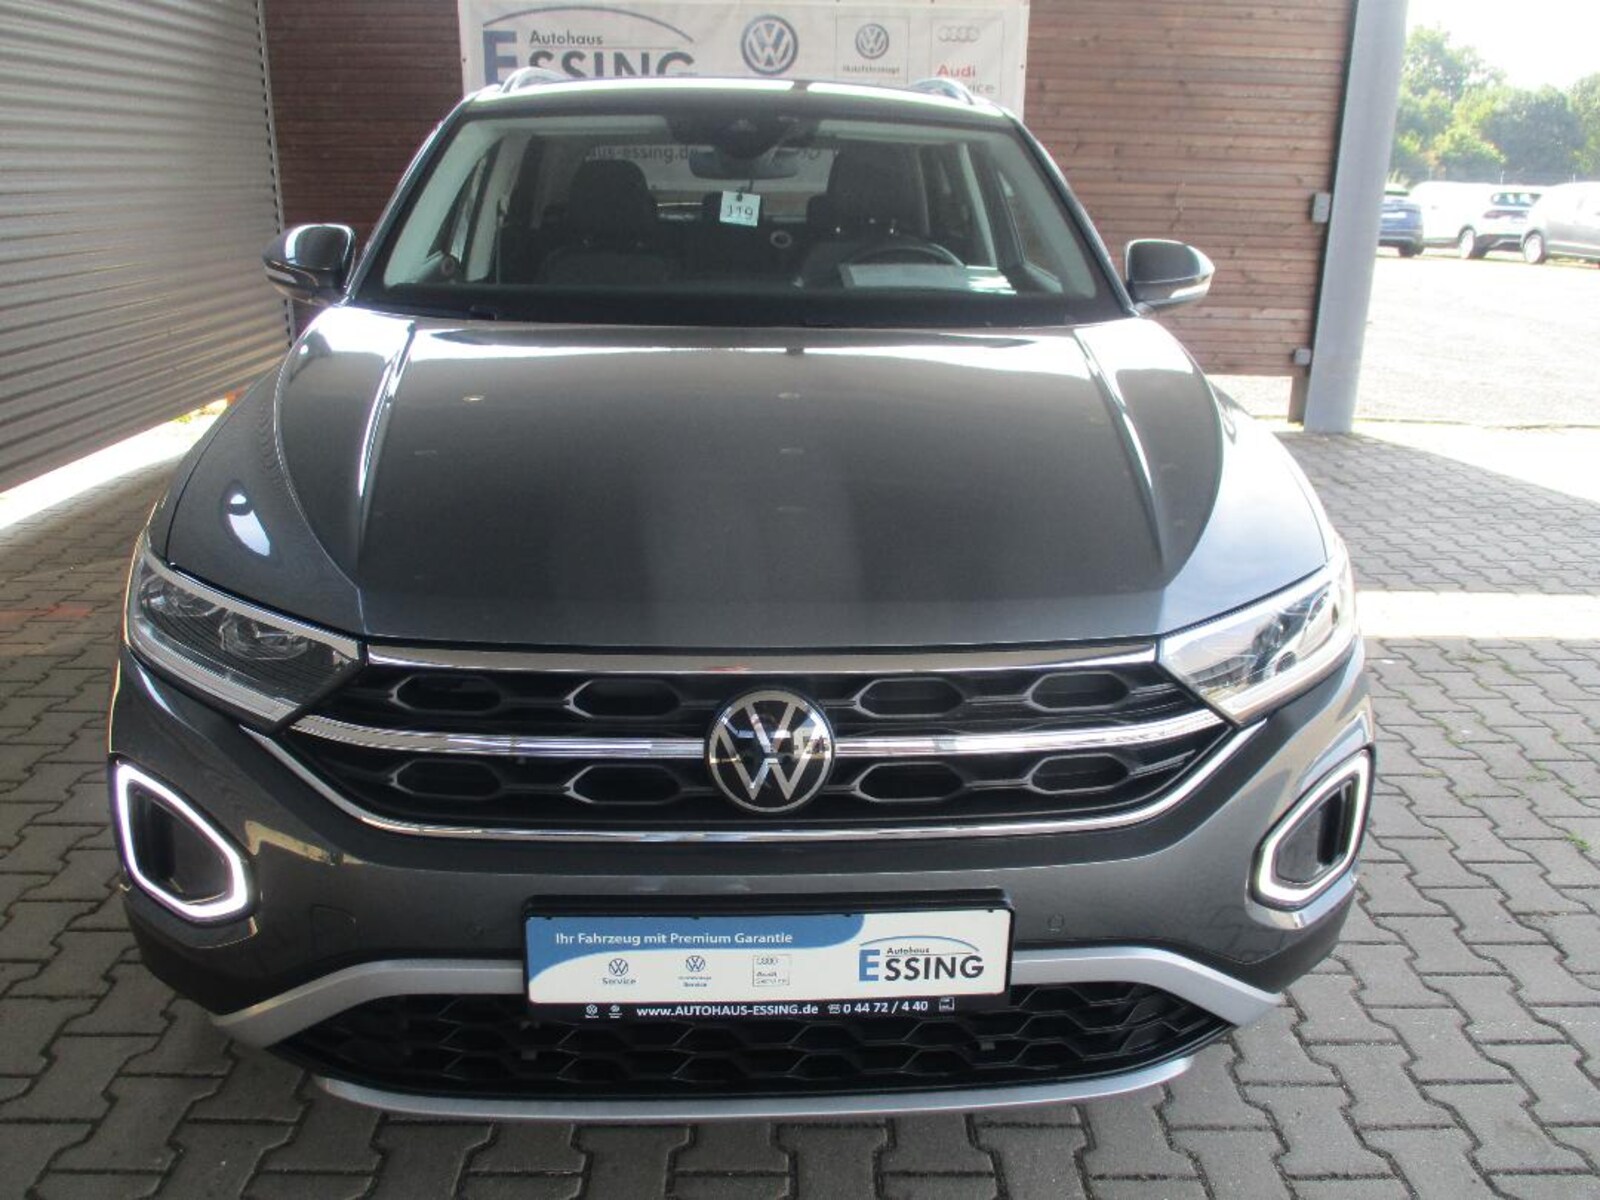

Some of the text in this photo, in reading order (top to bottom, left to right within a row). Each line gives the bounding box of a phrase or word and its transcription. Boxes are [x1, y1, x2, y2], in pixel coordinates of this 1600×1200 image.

[529, 30, 603, 45] Autohaus
[937, 65, 976, 77] Audi
[556, 932, 793, 946] Ihr Fahrzeug mit Premium Garantie
[887, 946, 930, 954] Autohaus
[859, 949, 984, 982] ESSING
[602, 977, 637, 985] Service
[636, 1003, 819, 1016] www.AUTOHAUS-ESSING.de
[843, 1003, 851, 1014] 0
[854, 1002, 869, 1013] 44
[873, 1002, 888, 1013] 72
[902, 1001, 910, 1011] 4
[912, 1000, 928, 1011] 40
